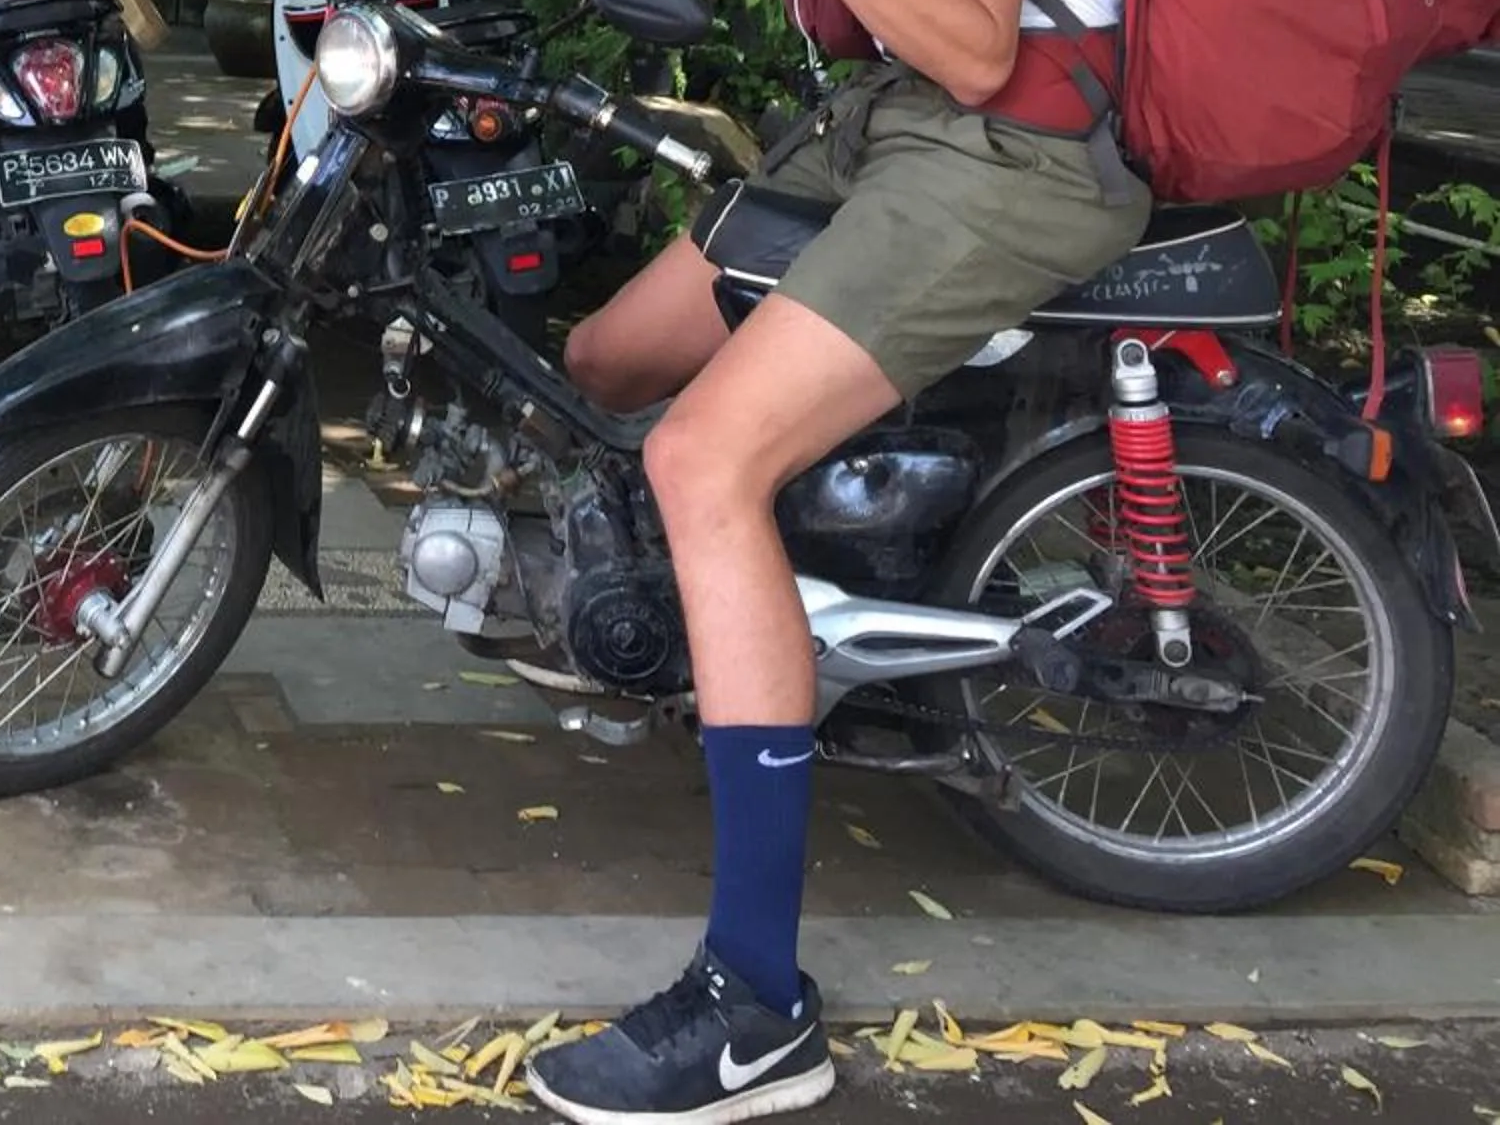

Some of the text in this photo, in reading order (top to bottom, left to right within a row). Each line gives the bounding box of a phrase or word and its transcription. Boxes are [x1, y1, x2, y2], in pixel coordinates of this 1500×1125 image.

[2, 159, 18, 182] P
[30, 148, 96, 176] 5634
[435, 188, 450, 209] P
